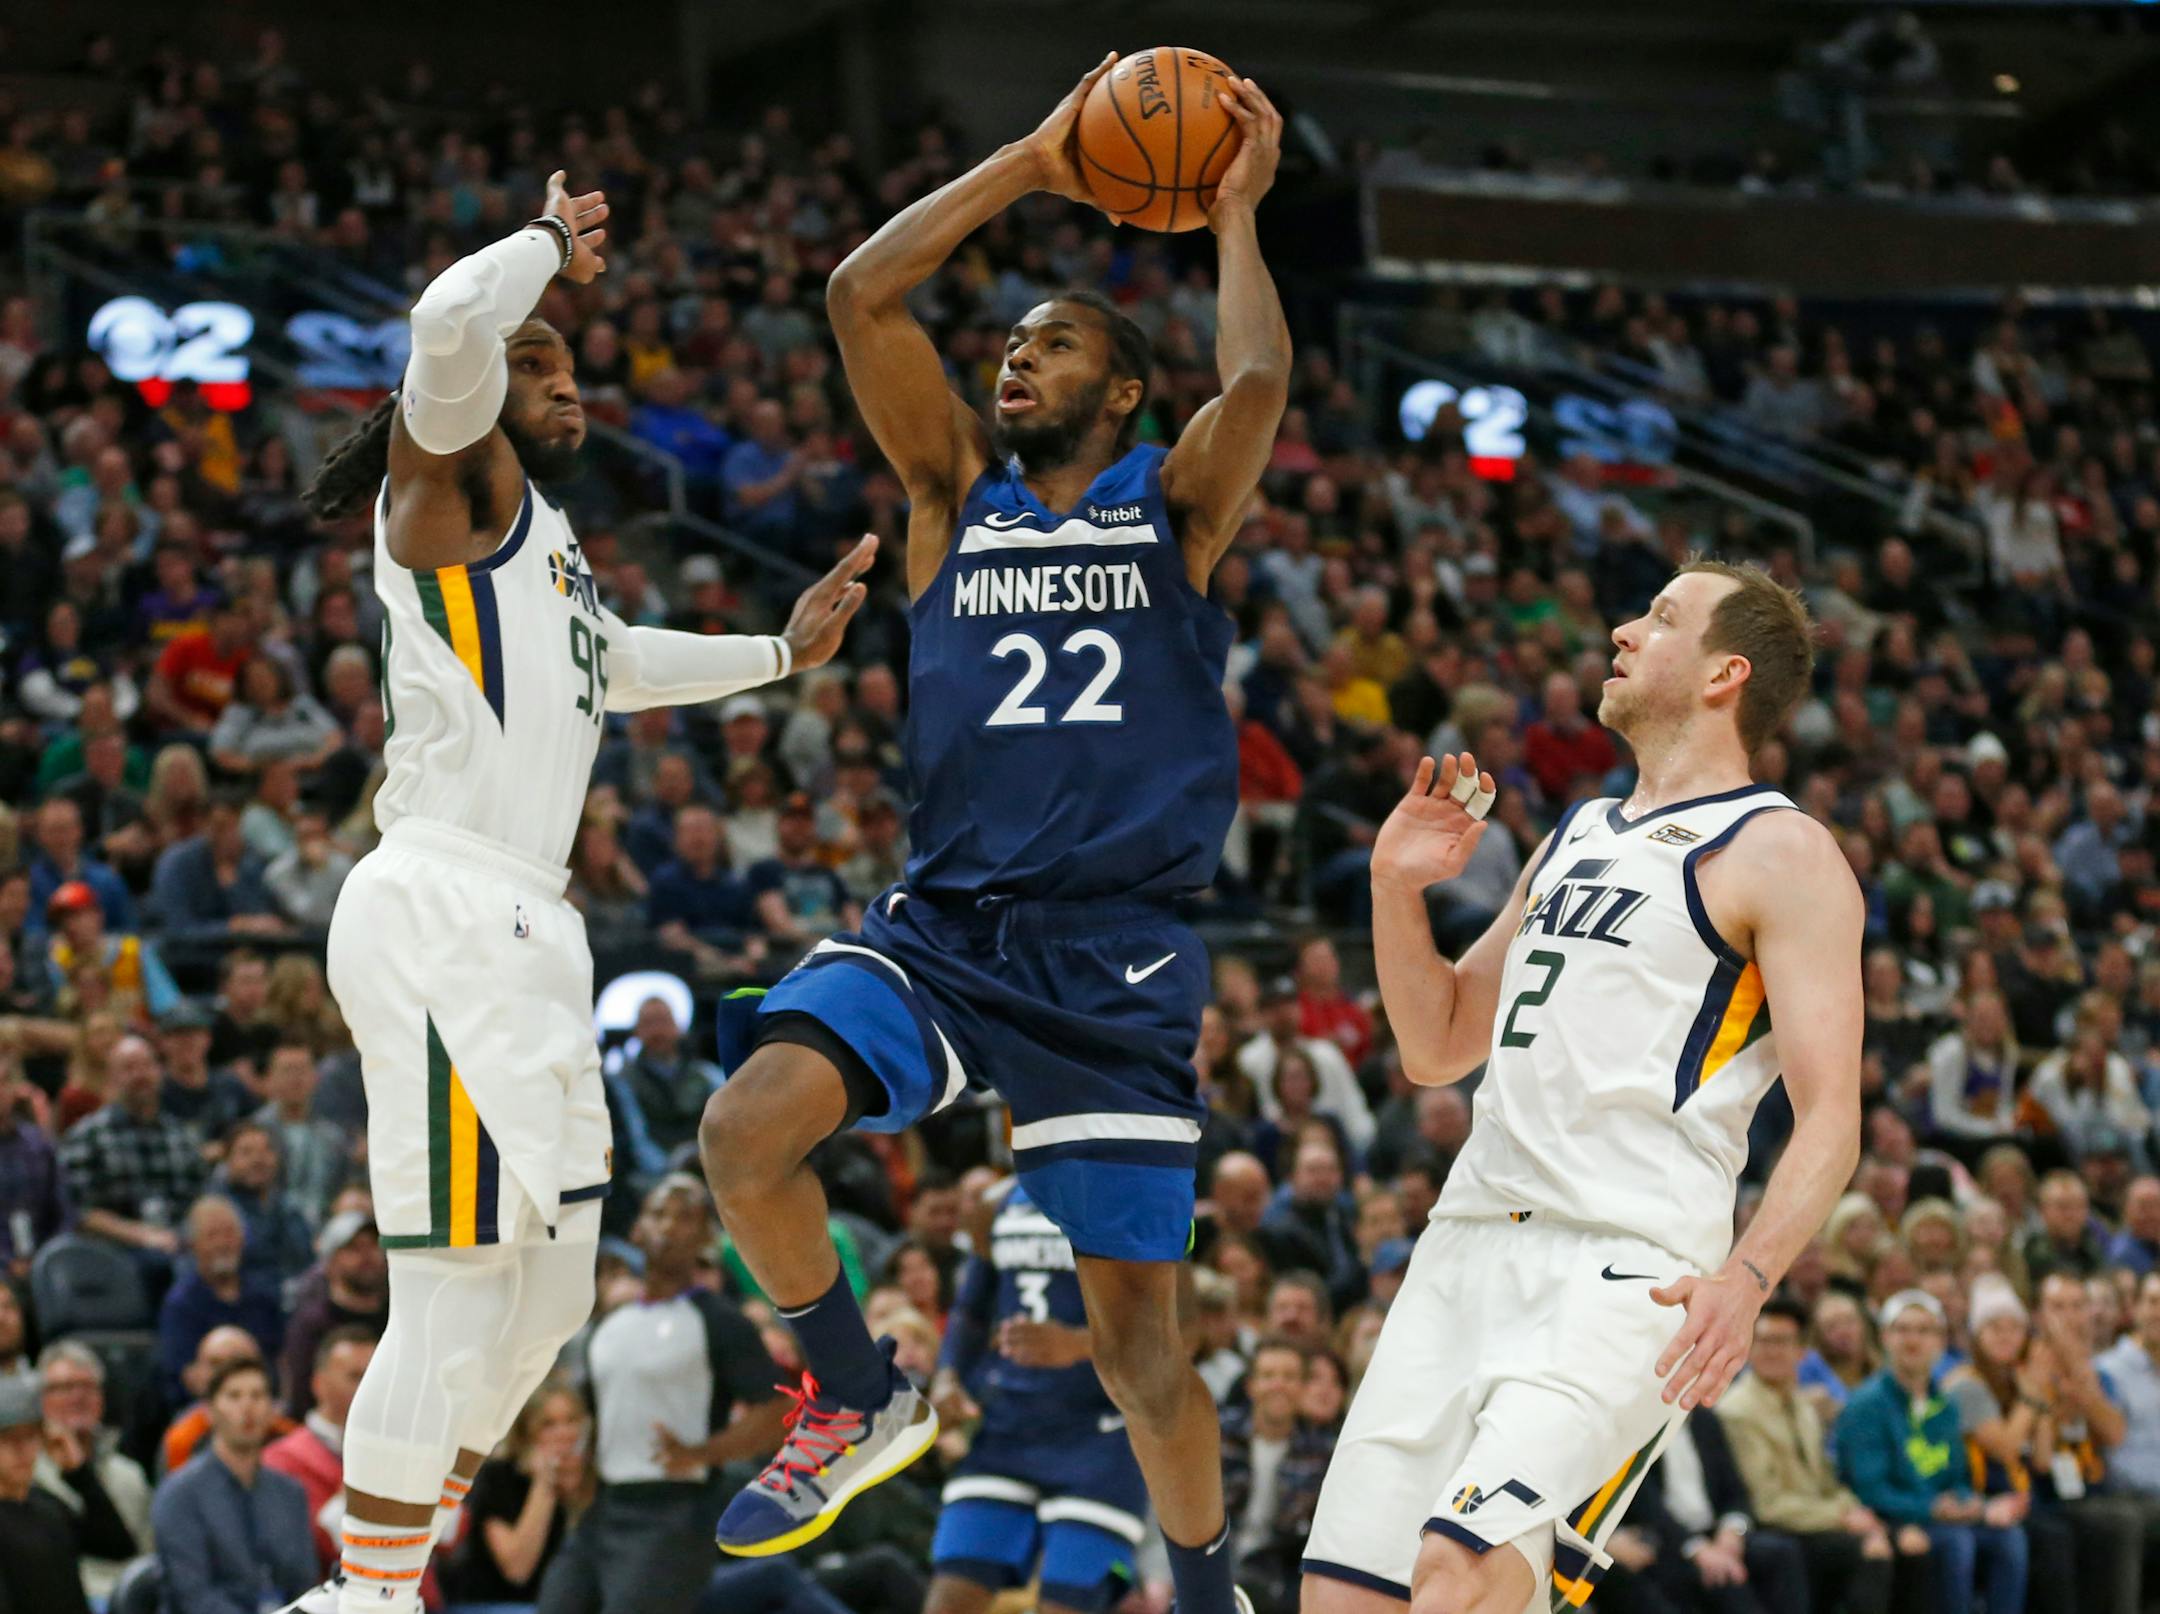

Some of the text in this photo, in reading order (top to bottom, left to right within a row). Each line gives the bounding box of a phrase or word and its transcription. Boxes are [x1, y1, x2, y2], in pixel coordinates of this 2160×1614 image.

[1100, 506, 1142, 522] fitbit
[954, 561, 1150, 617] MINNESOTA
[985, 628, 1123, 726] 22
[1517, 858, 1652, 948] JAZZ
[1500, 949, 1566, 1048] 2
[1015, 1271, 1051, 1324] 3
